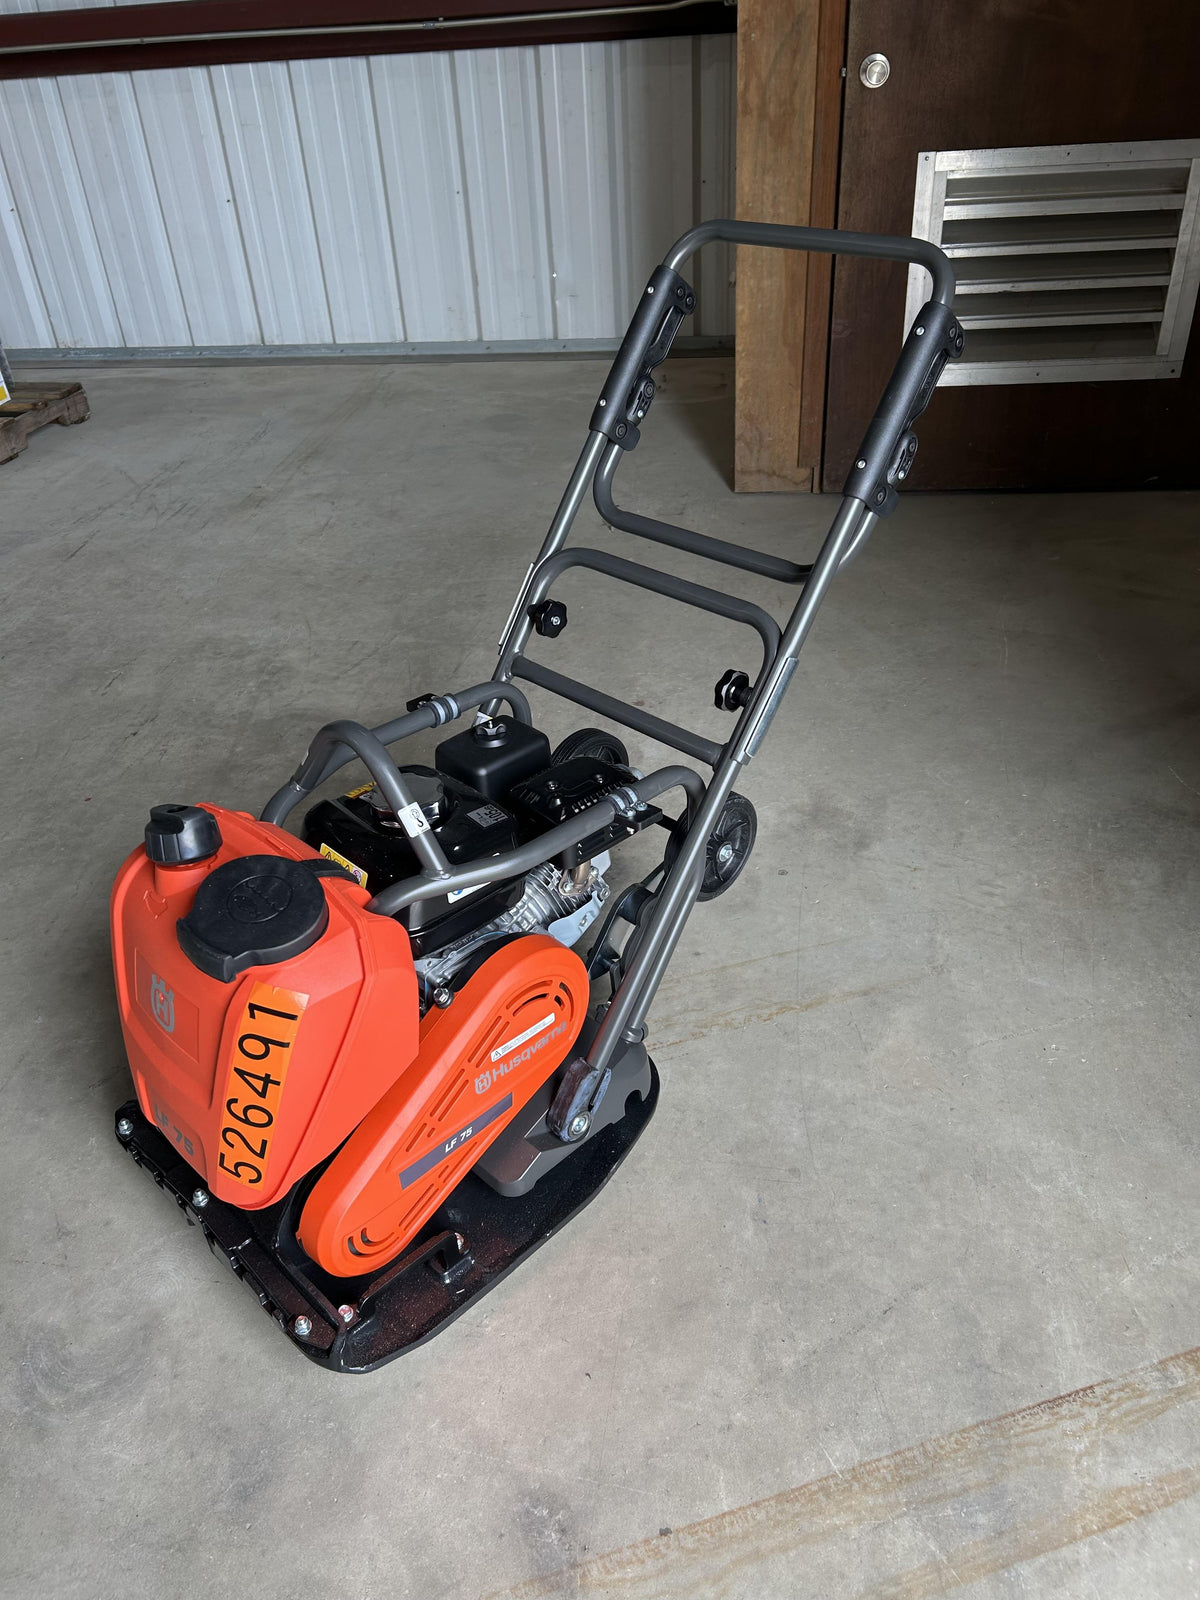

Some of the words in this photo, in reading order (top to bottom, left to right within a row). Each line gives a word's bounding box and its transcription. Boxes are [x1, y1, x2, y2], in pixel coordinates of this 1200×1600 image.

[492, 1021, 567, 1082] Husqvarna
[218, 1002, 298, 1184] 526491
[153, 1103, 169, 1128] LF
[173, 1125, 194, 1156] 75
[445, 1137, 457, 1153] LF
[460, 1126, 473, 1141] 75
